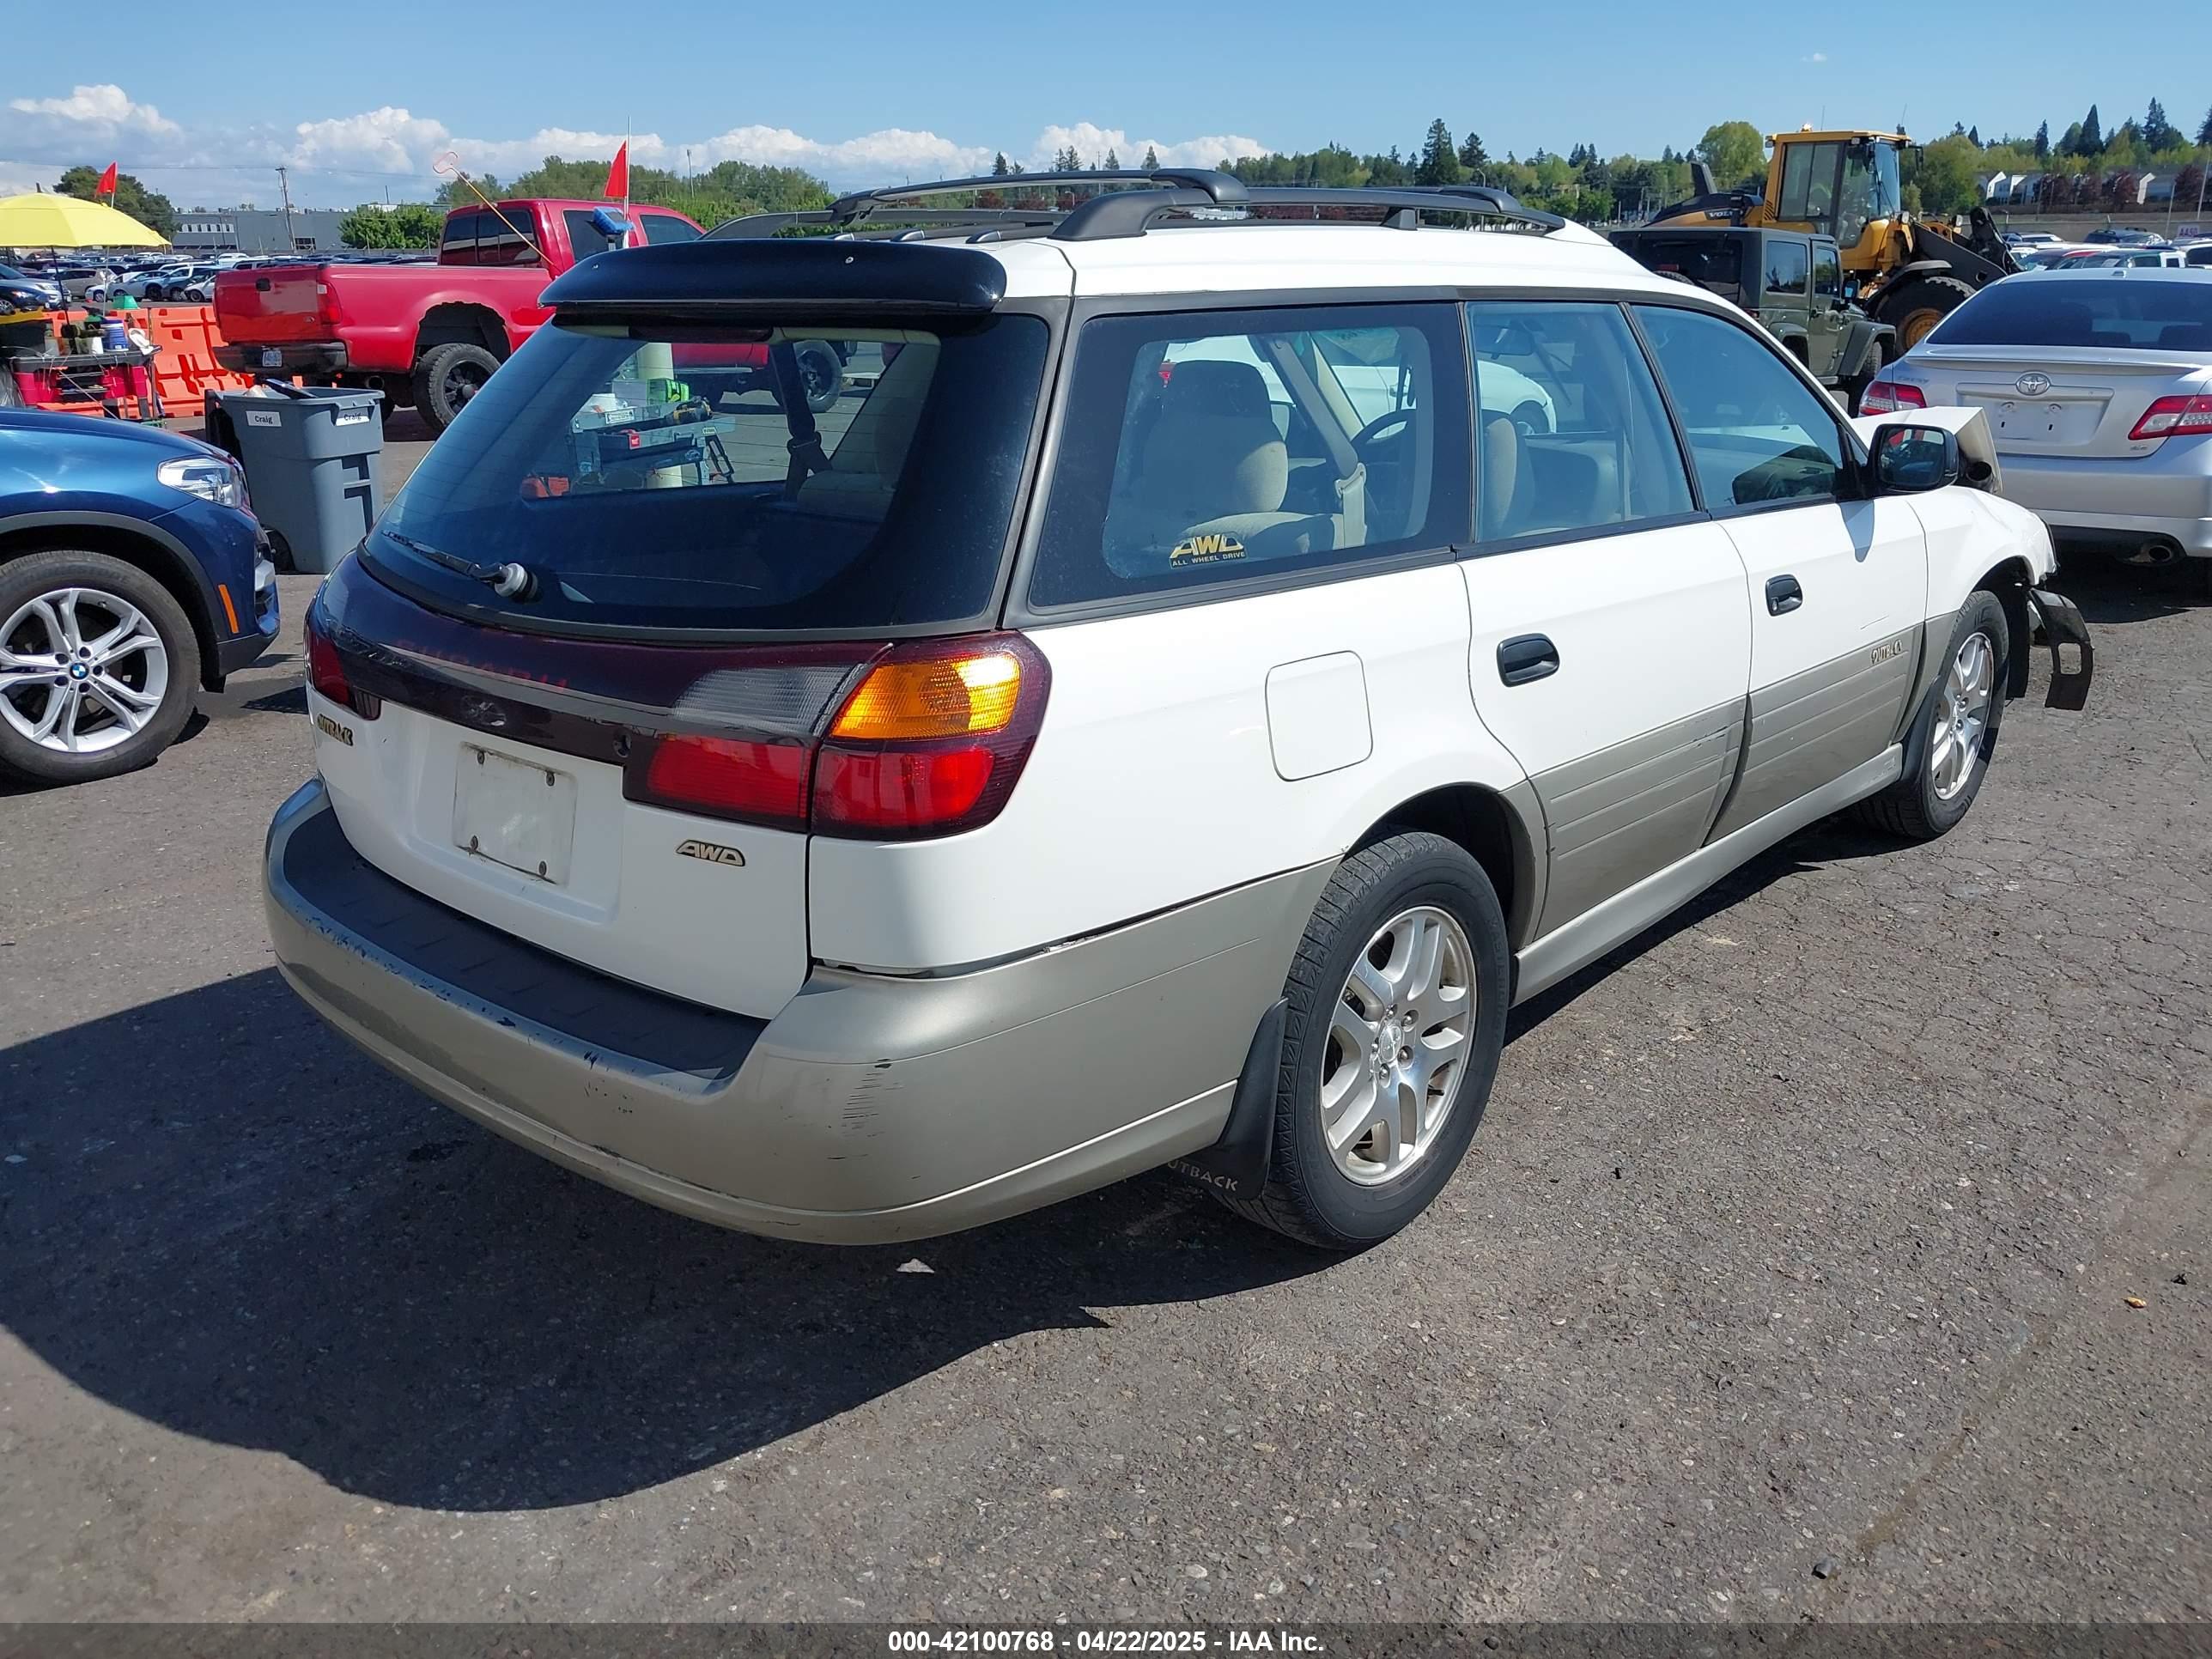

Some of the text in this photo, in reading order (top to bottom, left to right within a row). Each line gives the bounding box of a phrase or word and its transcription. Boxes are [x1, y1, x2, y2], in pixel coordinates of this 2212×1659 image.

[254, 415, 273, 424] Craig
[1170, 533, 1244, 558] AWD
[1192, 554, 1220, 564] WHEEL
[1222, 551, 1246, 560] DRIVE
[675, 839, 745, 867] AWD
[1167, 1159, 1239, 1192] UTBACK
